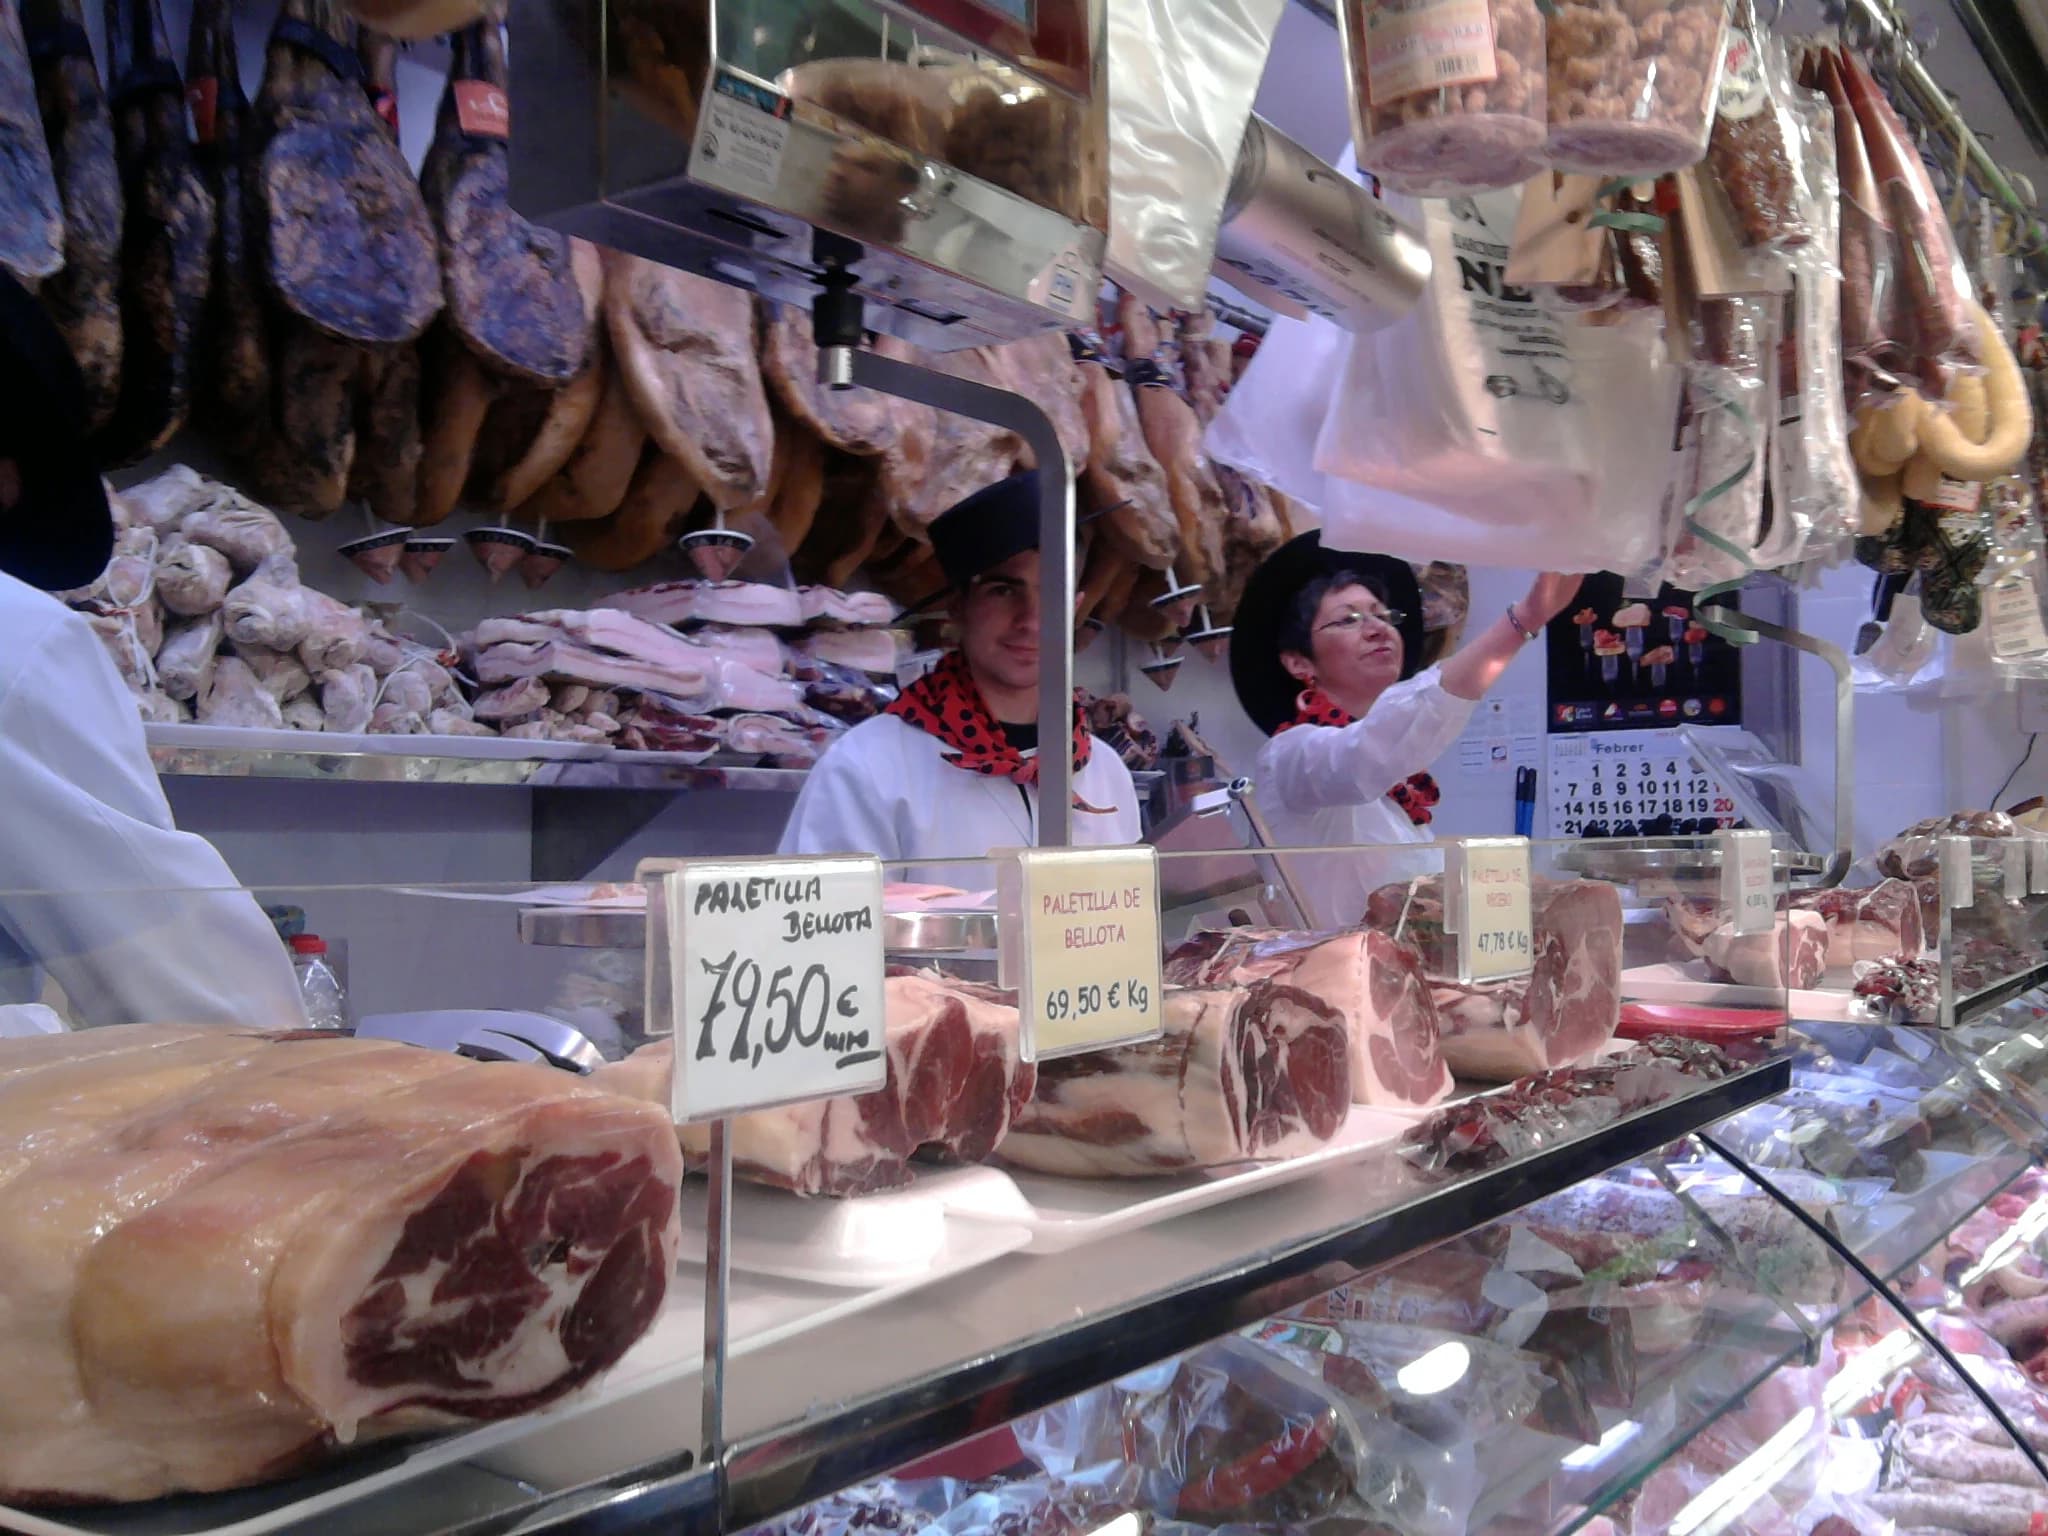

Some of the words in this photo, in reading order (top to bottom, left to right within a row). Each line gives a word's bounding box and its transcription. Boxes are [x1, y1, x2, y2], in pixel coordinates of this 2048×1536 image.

[1595, 743, 1644, 755] Febrer
[1592, 764, 1600, 778] 1
[1616, 763, 1627, 778] 2
[1641, 762, 1652, 776] 3
[1666, 761, 1677, 775] 4
[1568, 783, 1578, 797] 7
[1592, 782, 1602, 796] 8
[1616, 782, 1627, 796] 9
[1637, 781, 1657, 795] 10
[1662, 780, 1681, 794] 11
[1687, 780, 1708, 794] 12
[1564, 802, 1583, 815] 14
[1589, 801, 1608, 815] 15
[1613, 801, 1633, 815] 16
[1638, 800, 1657, 814] 17
[1662, 799, 1682, 813] 18
[1688, 798, 1708, 812] 19
[1713, 798, 1734, 812] 20
[1564, 820, 1582, 834] 21
[694, 876, 821, 915] PALETILLA
[1043, 889, 1118, 915] PALETILLA
[1123, 888, 1141, 908] DE
[782, 906, 872, 943] BELLOTA
[1064, 925, 1125, 948] BELLOTA
[1477, 932, 1504, 957] 47,78
[1517, 930, 1528, 954] Kg
[1046, 984, 1101, 1021] 69,50
[1107, 982, 1120, 1009] €
[1128, 979, 1148, 1013] Kg
